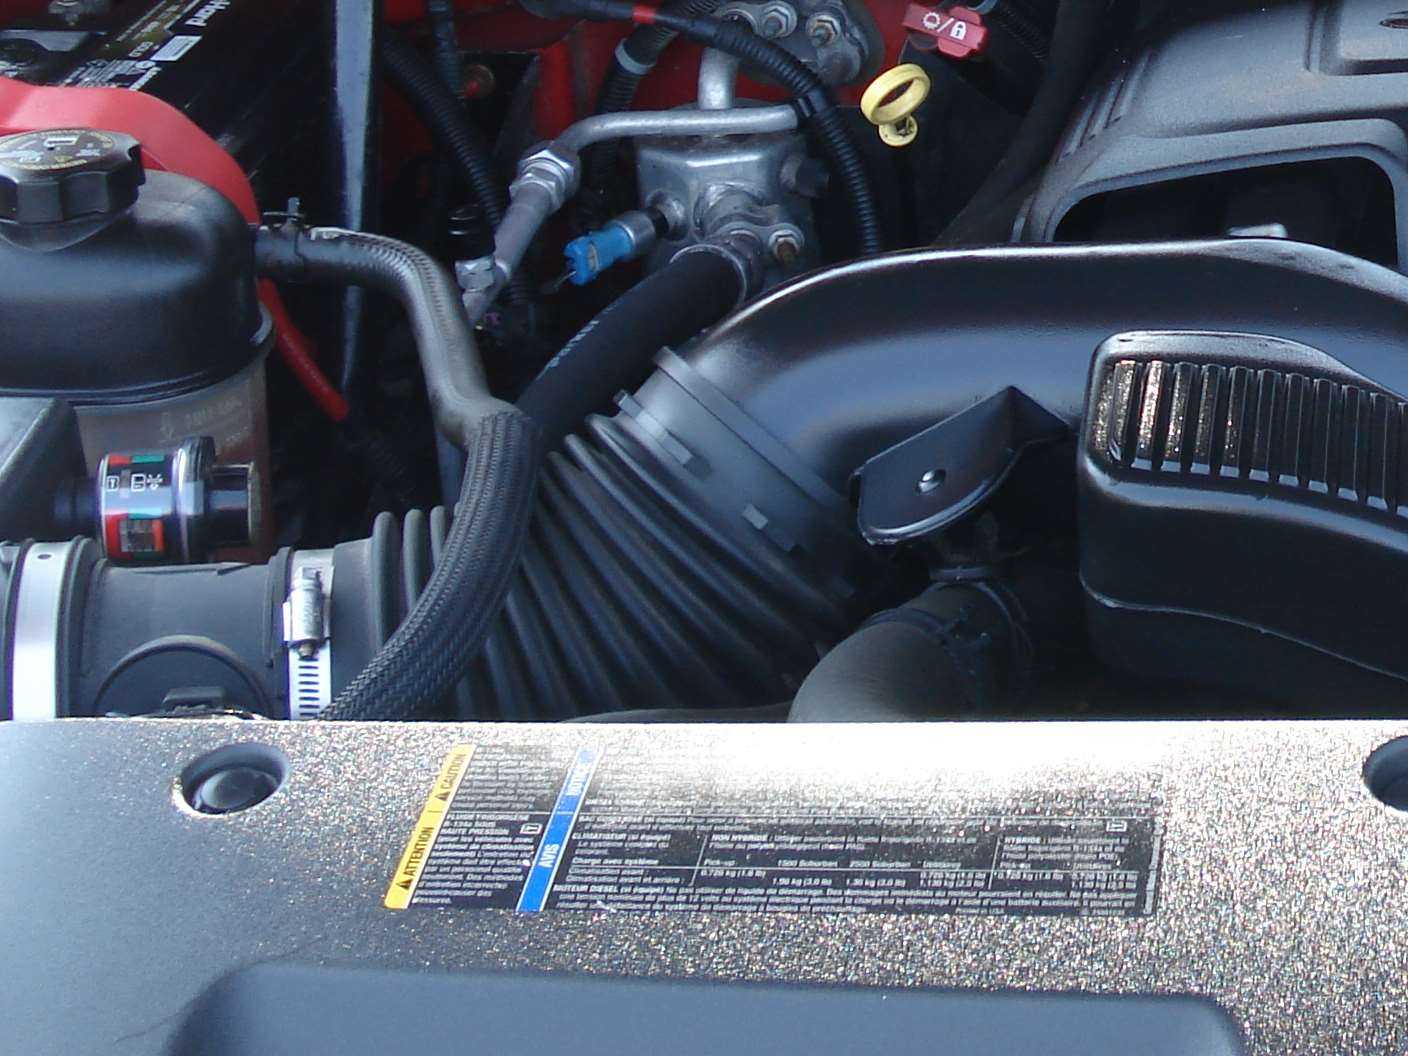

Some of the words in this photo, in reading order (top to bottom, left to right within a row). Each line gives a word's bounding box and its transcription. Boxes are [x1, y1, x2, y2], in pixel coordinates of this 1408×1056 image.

[440, 753, 467, 790] CAUTION
[403, 826, 435, 876] ATTENTION
[538, 844, 560, 868] AVIS
